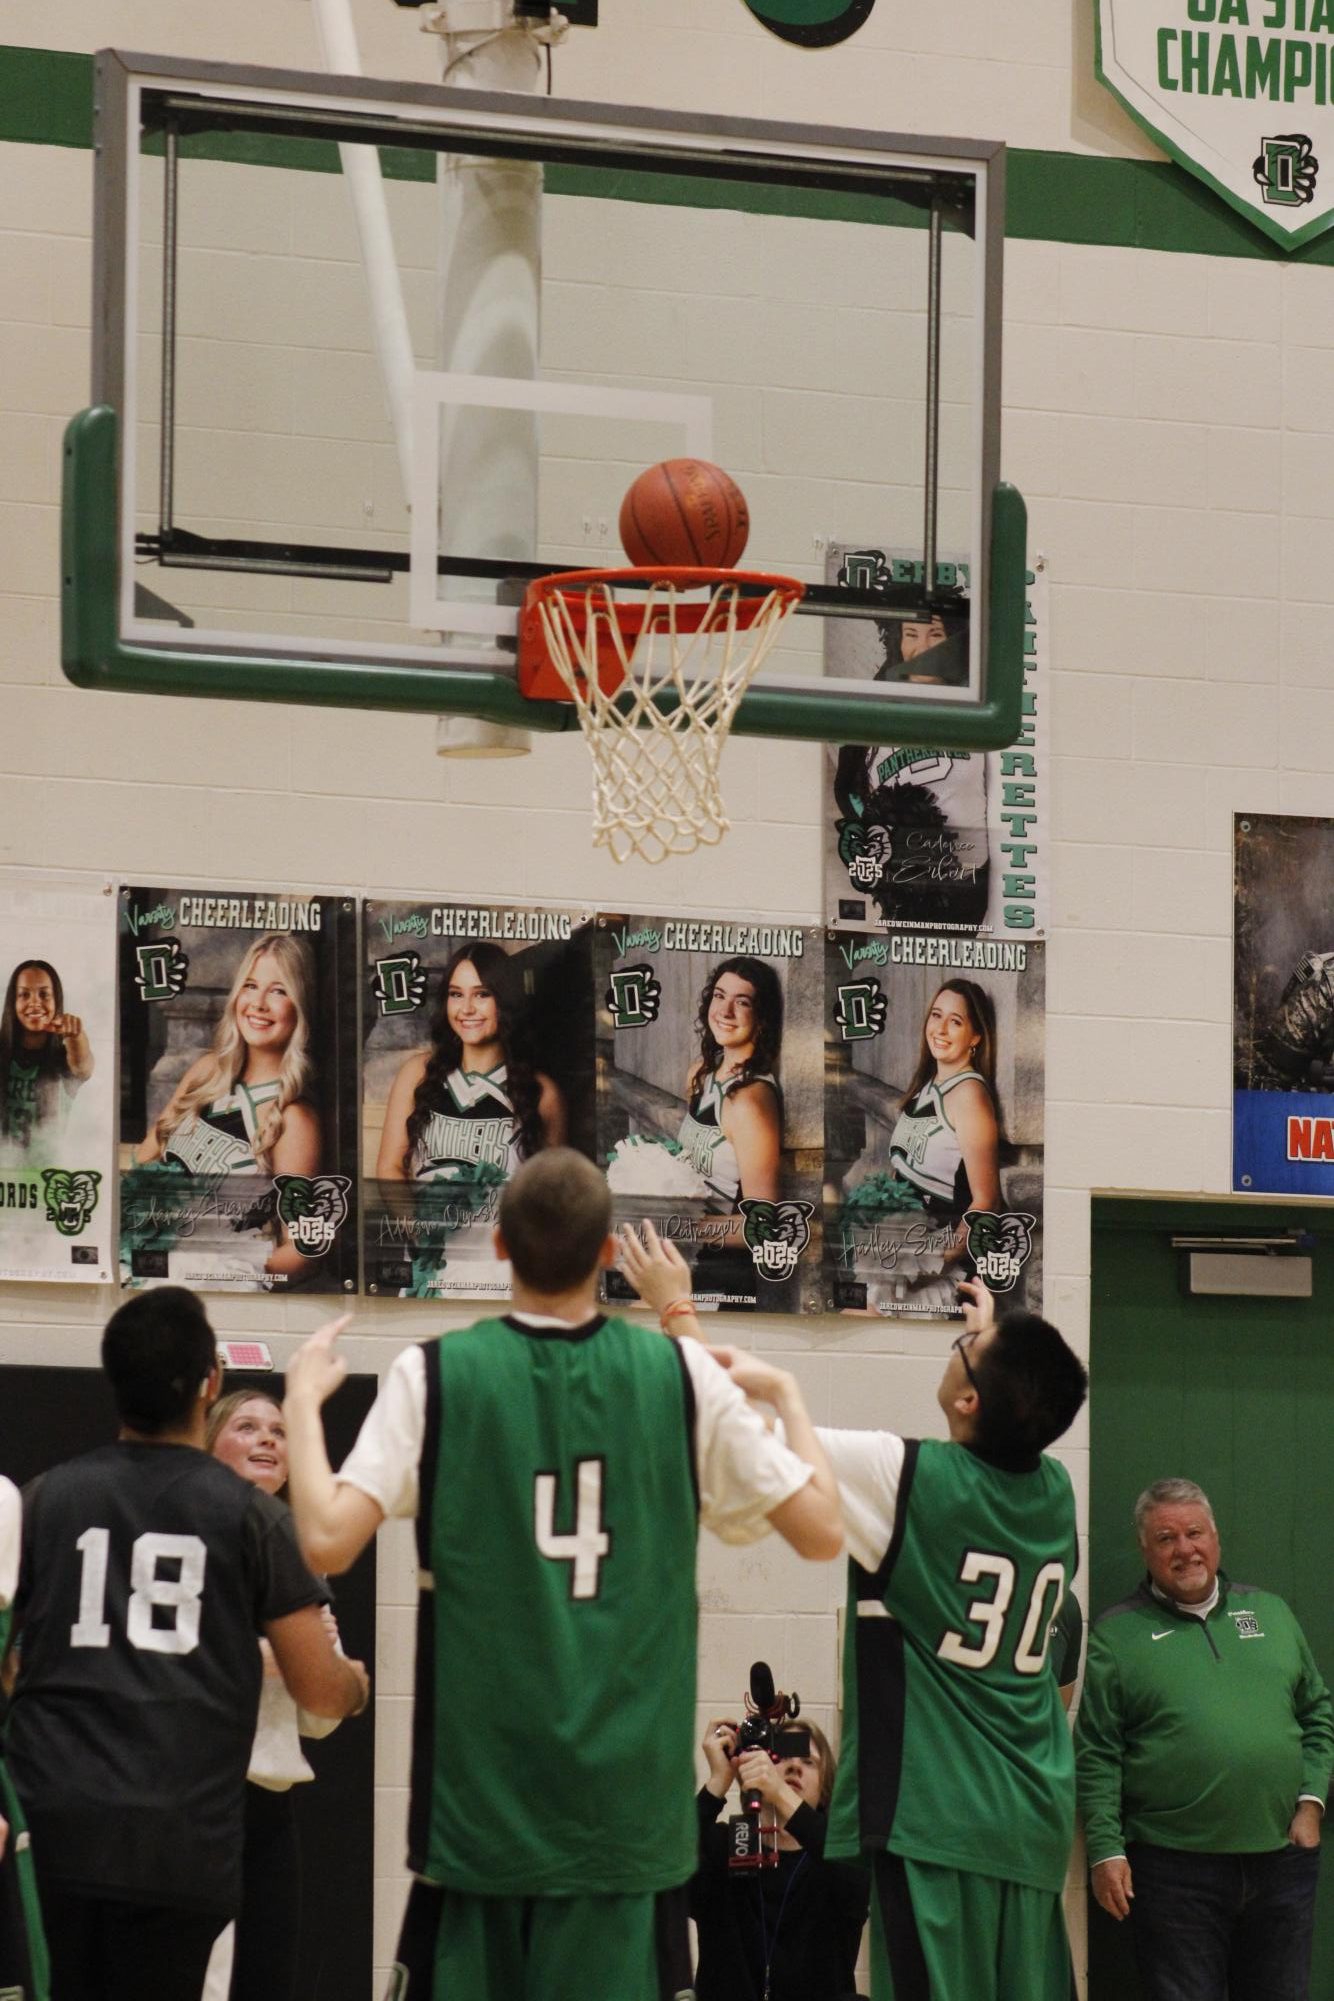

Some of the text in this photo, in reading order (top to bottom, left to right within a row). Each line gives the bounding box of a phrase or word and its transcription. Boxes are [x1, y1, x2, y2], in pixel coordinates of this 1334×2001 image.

[1157, 27, 1334, 105] CHAMPI
[180, 897, 321, 931] CHEERLEADING
[431, 908, 571, 940] CHEERLEADING
[664, 922, 804, 957] CHEERLEADING
[891, 936, 1027, 970] CHEERLEADING
[1287, 1115, 1334, 1161] NA
[46, 1206, 91, 1223] 25
[288, 1220, 335, 1241] 2025
[753, 1244, 798, 1265] 2025
[977, 1256, 1020, 1276] 2025
[532, 1458, 612, 1600] 4
[70, 1527, 207, 1655] 18
[936, 1549, 1066, 1675] 30
[735, 1822, 749, 1857] REVO
